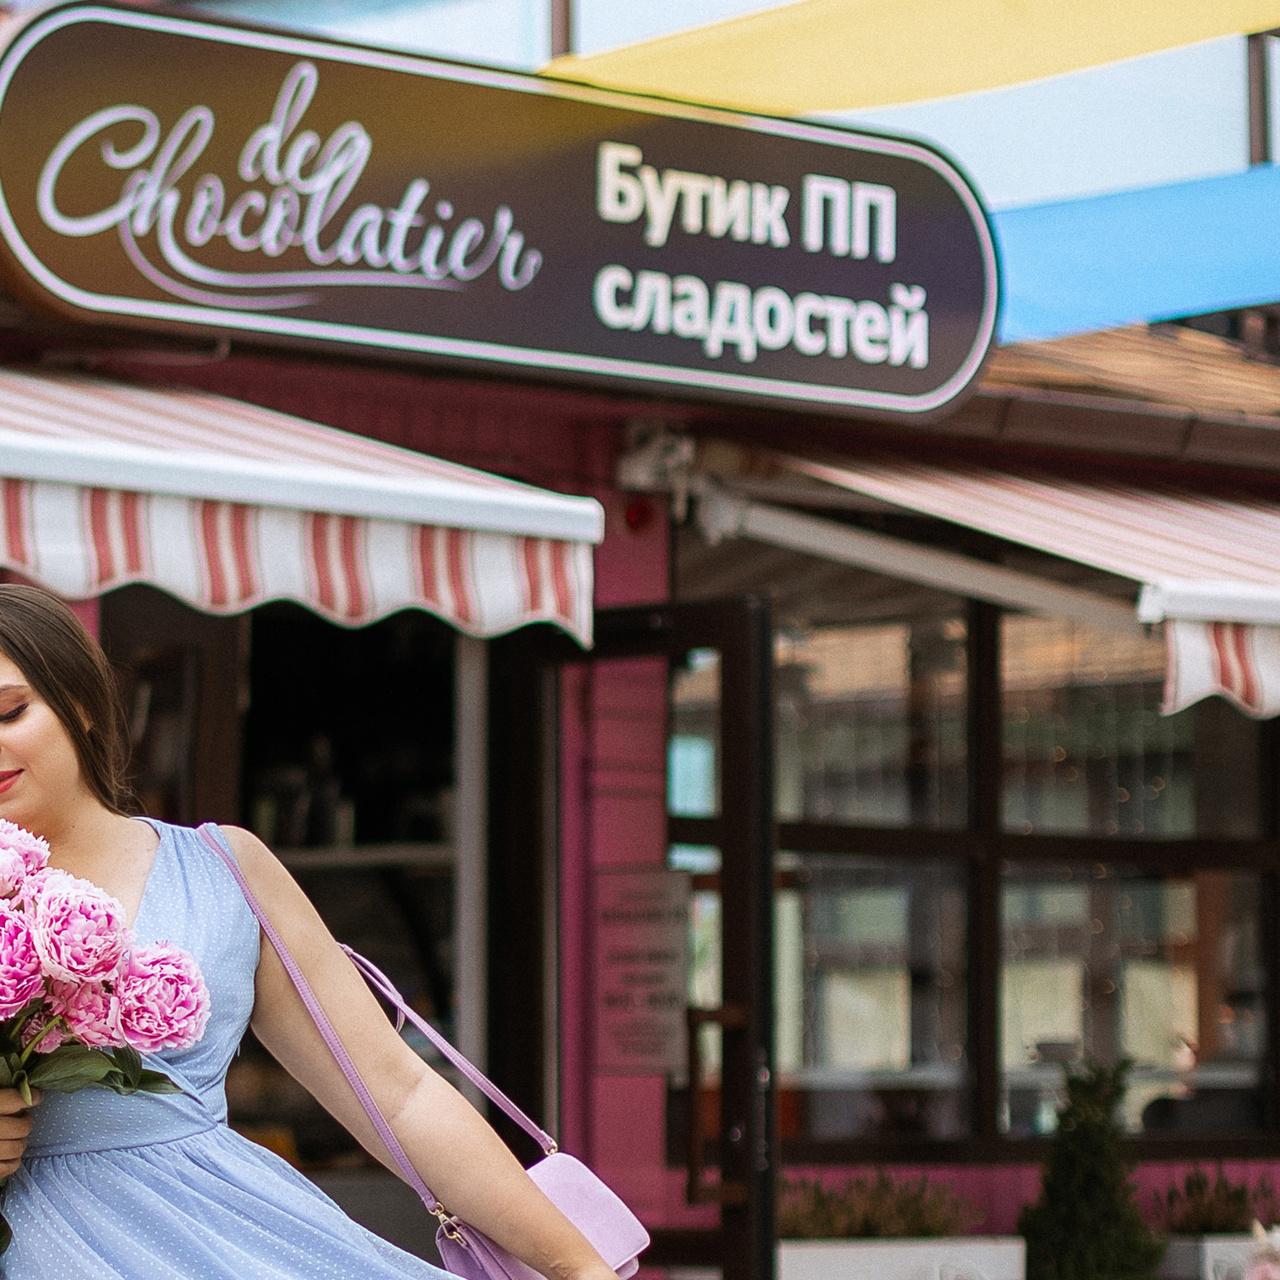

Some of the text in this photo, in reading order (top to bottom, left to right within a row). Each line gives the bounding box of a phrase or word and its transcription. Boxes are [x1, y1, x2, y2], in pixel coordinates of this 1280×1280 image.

[36, 102, 543, 295] Chocolatier
[596, 140, 897, 264] Бутик ПП
[593, 263, 929, 370] сладостей
